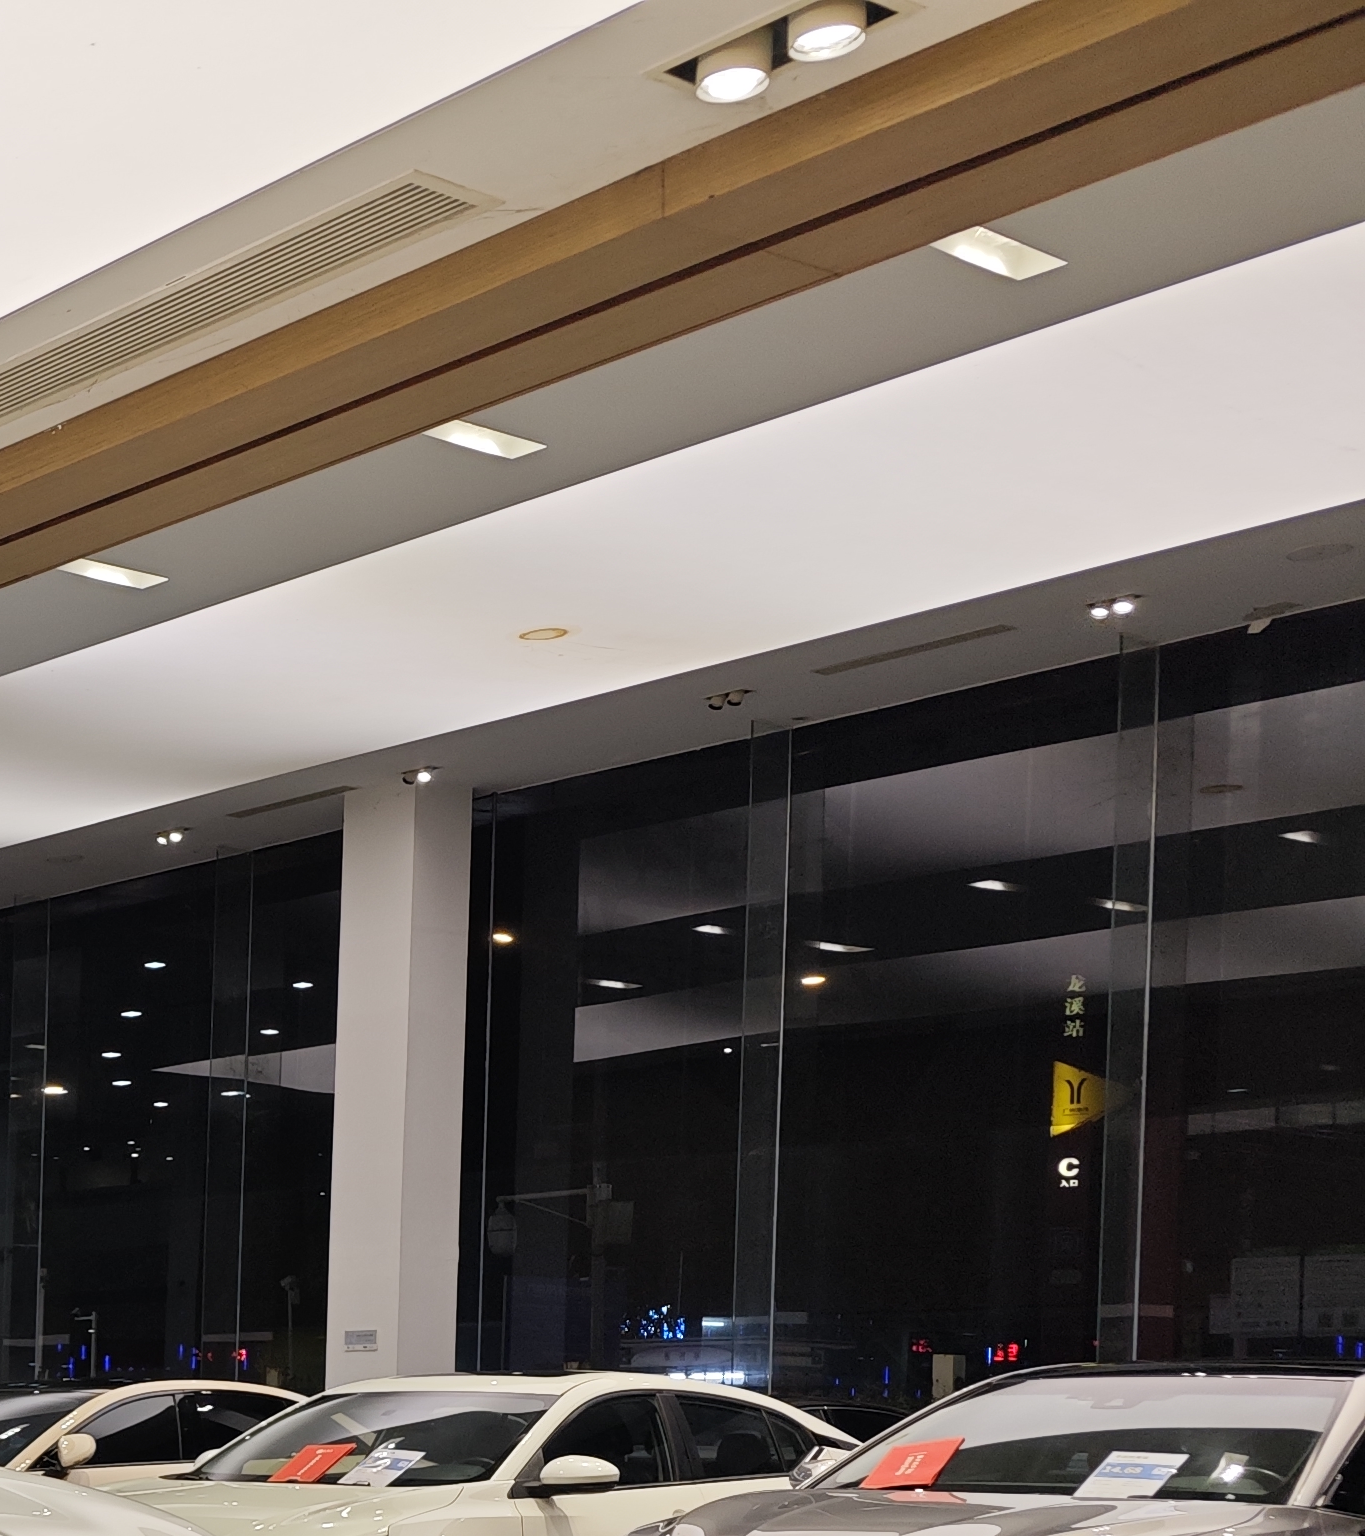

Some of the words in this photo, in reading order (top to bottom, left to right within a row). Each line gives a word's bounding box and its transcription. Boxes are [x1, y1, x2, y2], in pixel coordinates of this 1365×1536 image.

[1063, 974, 1086, 1038] 龙溪站
[1058, 1157, 1080, 1177] C
[1059, 1178, 1079, 1188] 入口
